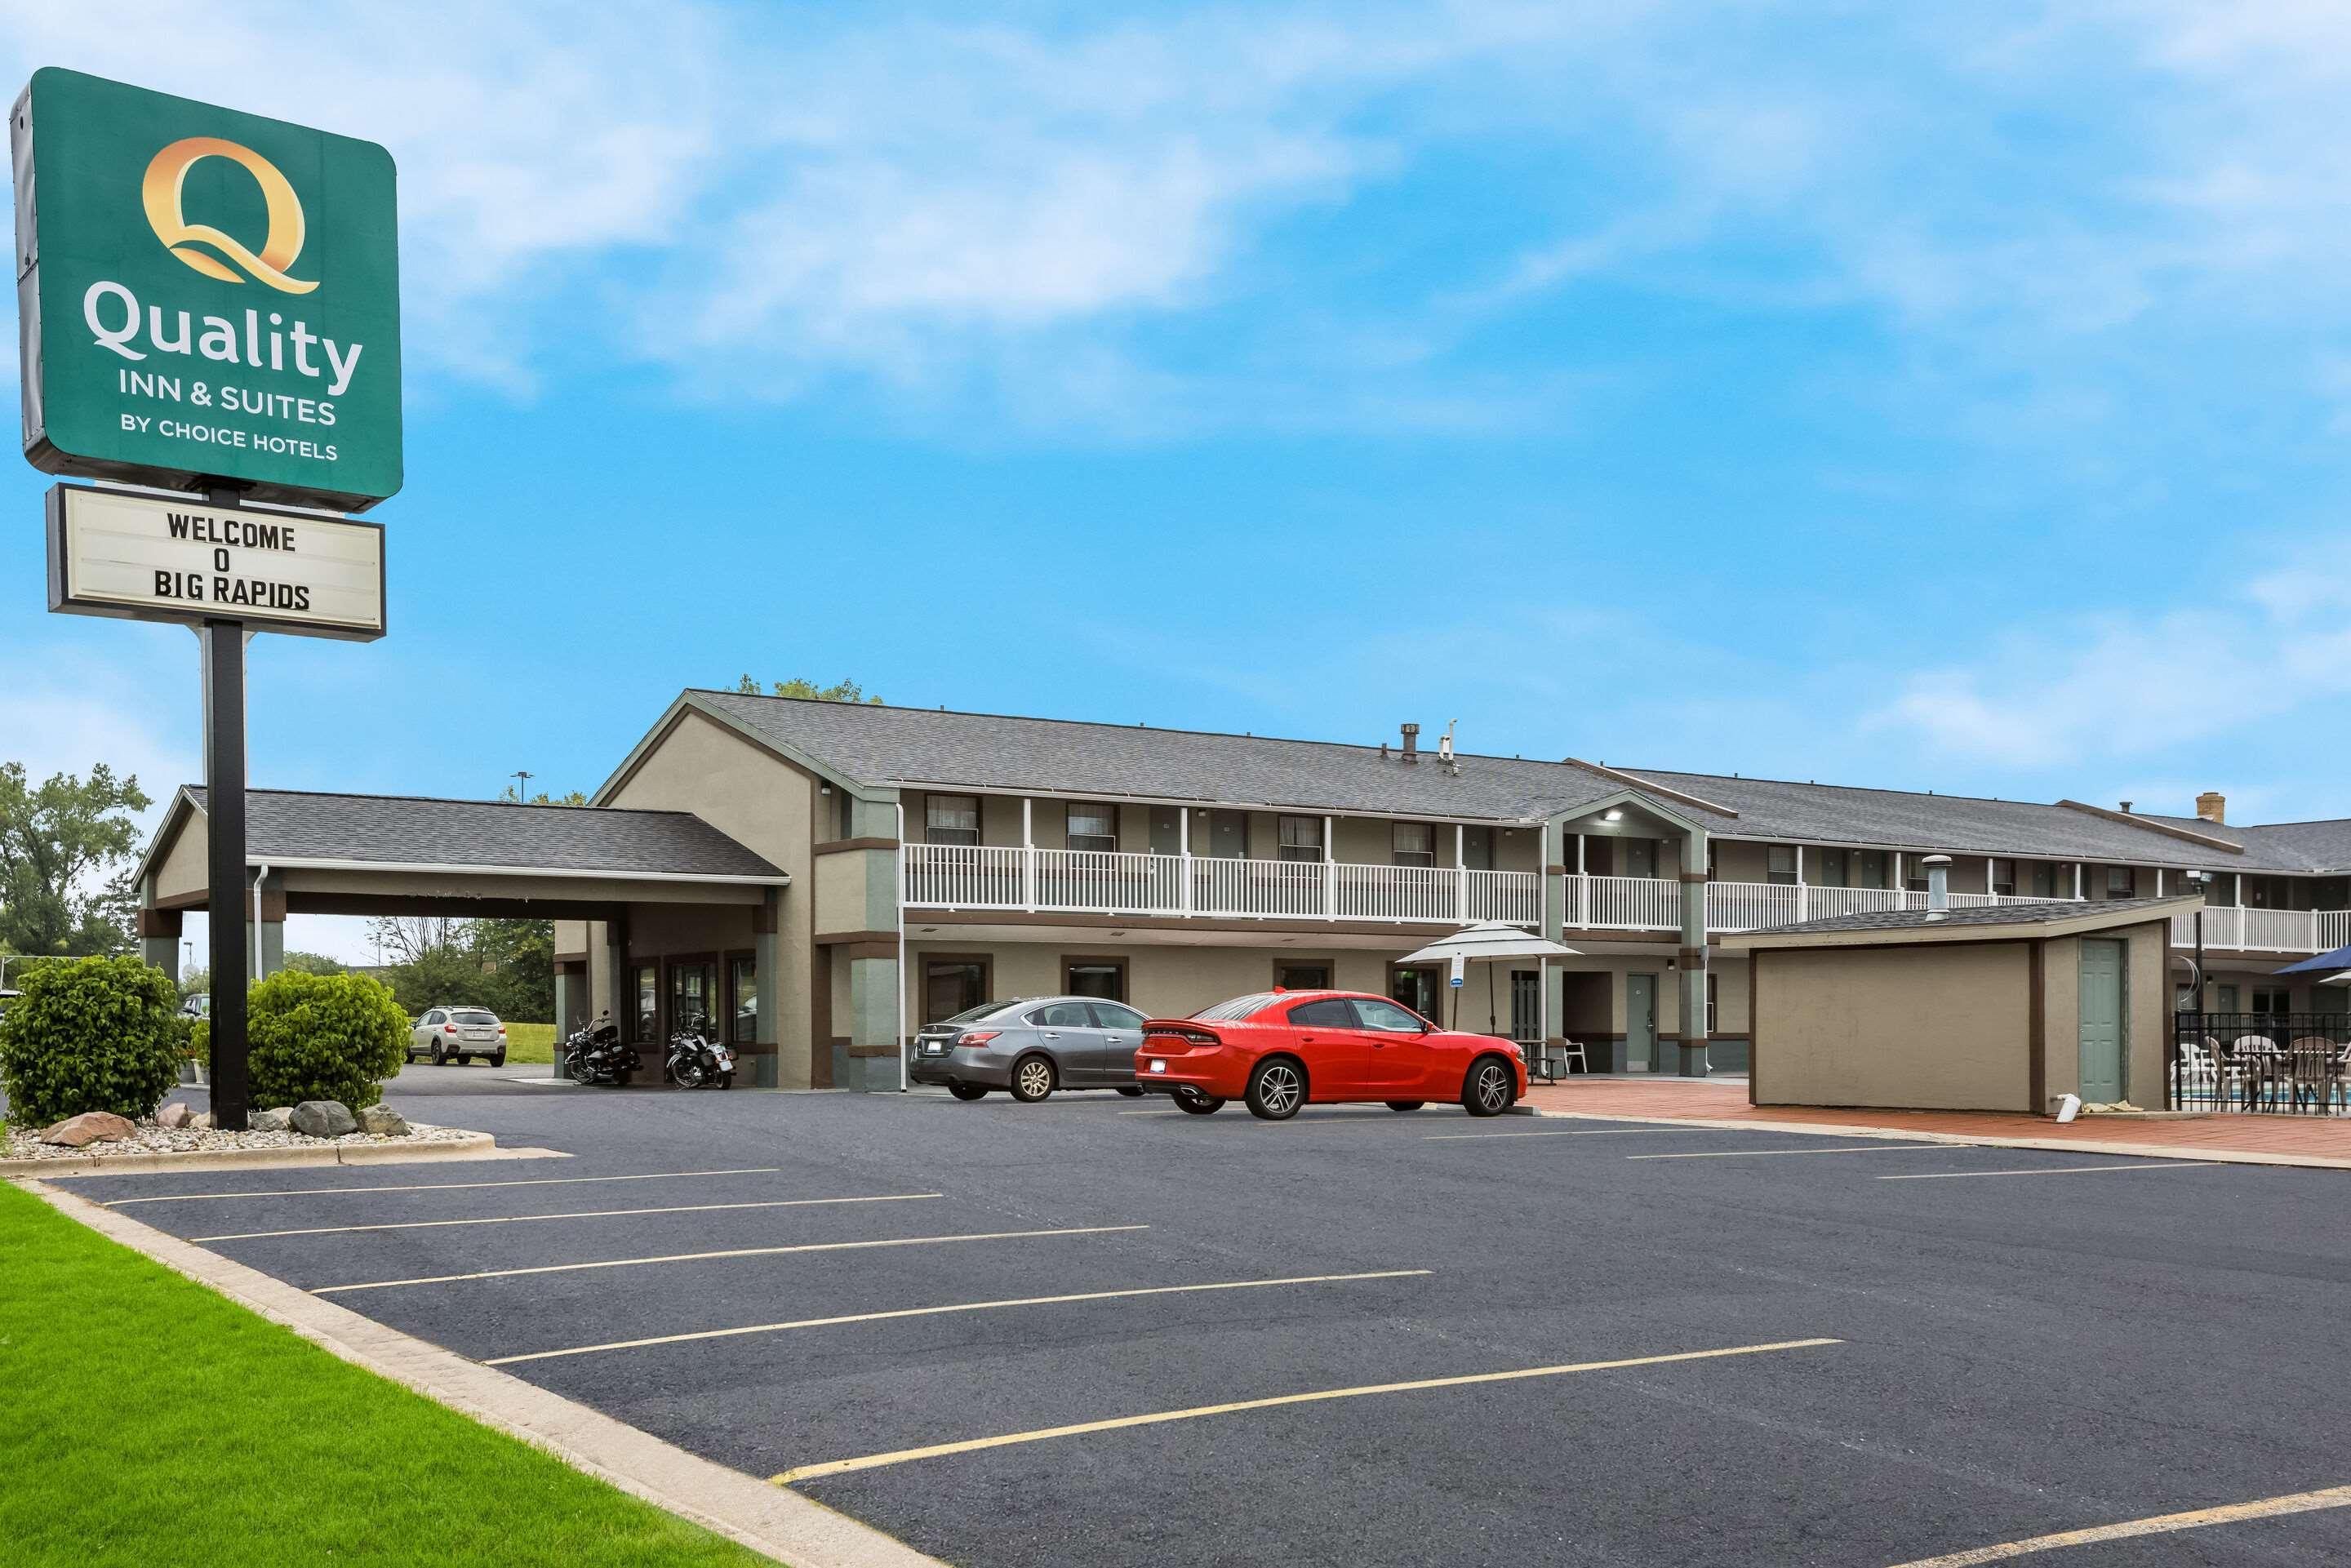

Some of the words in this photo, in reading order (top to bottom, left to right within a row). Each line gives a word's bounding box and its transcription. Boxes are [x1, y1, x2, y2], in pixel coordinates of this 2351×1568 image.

[83, 281, 363, 396] Quality
[120, 369, 181, 402] INN
[190, 381, 212, 406] &
[220, 386, 336, 425] SUITES
[121, 414, 151, 433] BY
[159, 420, 247, 447] CHOICE
[254, 433, 338, 461] HOTELS
[167, 513, 296, 552] WELCOME
[154, 570, 203, 602] BIG
[213, 576, 309, 611] RAPIDS
